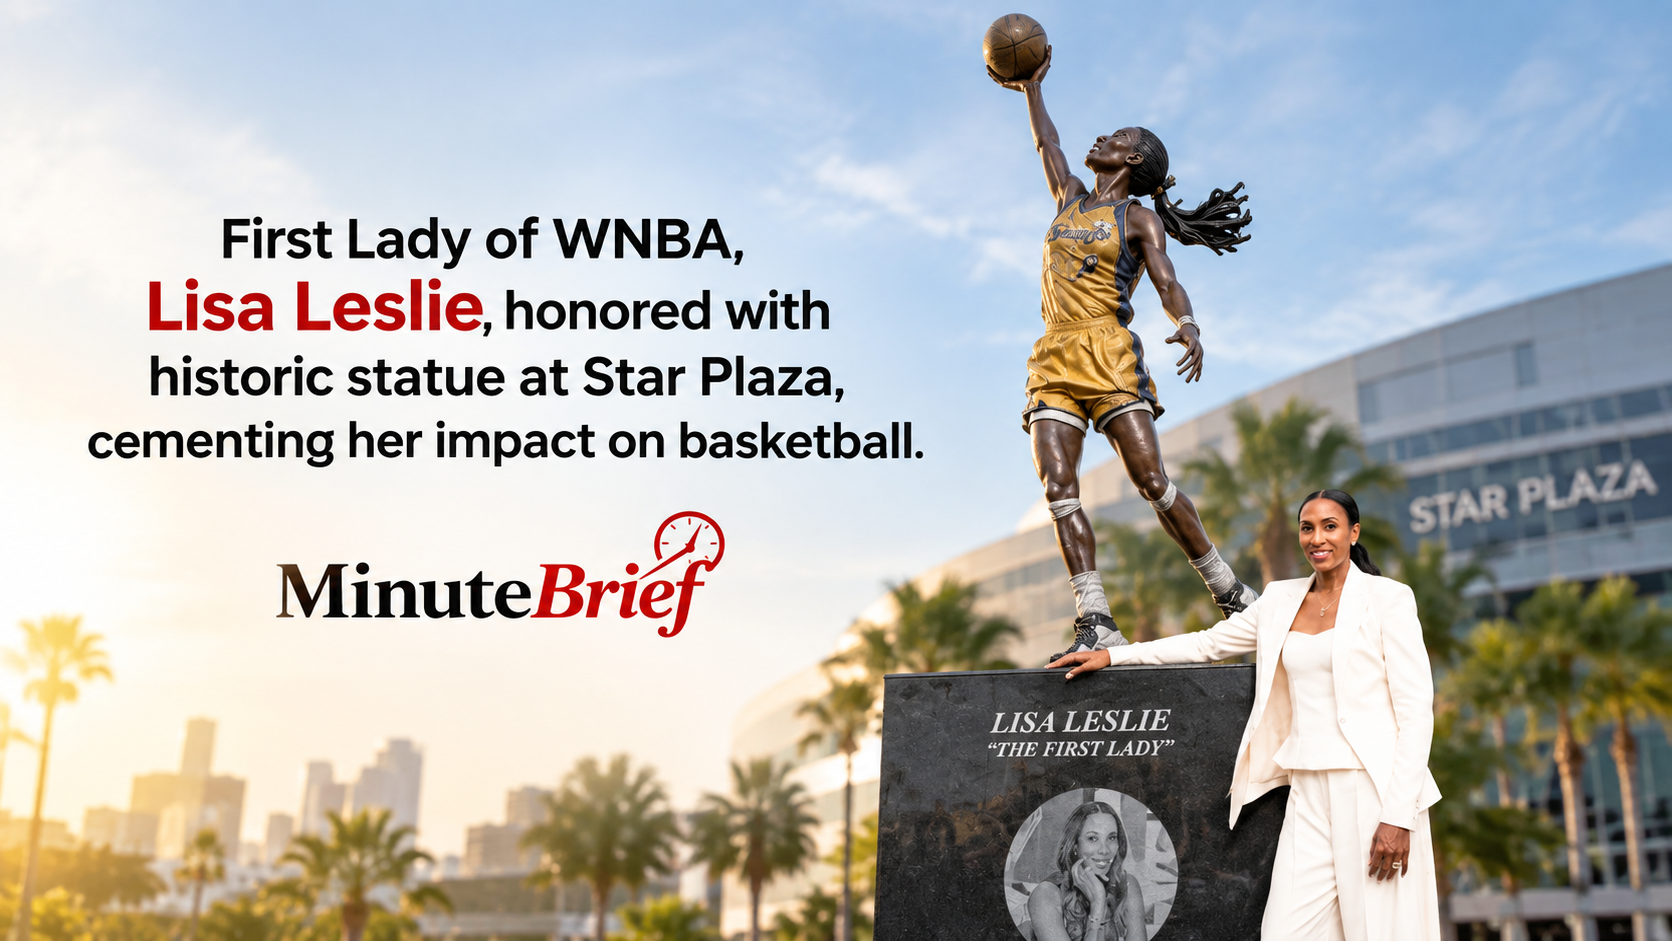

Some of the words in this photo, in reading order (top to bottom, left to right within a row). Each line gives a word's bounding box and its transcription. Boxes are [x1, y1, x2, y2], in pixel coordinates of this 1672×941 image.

[1409, 484, 1510, 534] STAR
[1518, 460, 1658, 515] PLAZA
[990, 711, 1055, 734] LISA
[1062, 709, 1171, 733] LESLIE
[1043, 740, 1104, 757] FIRST
